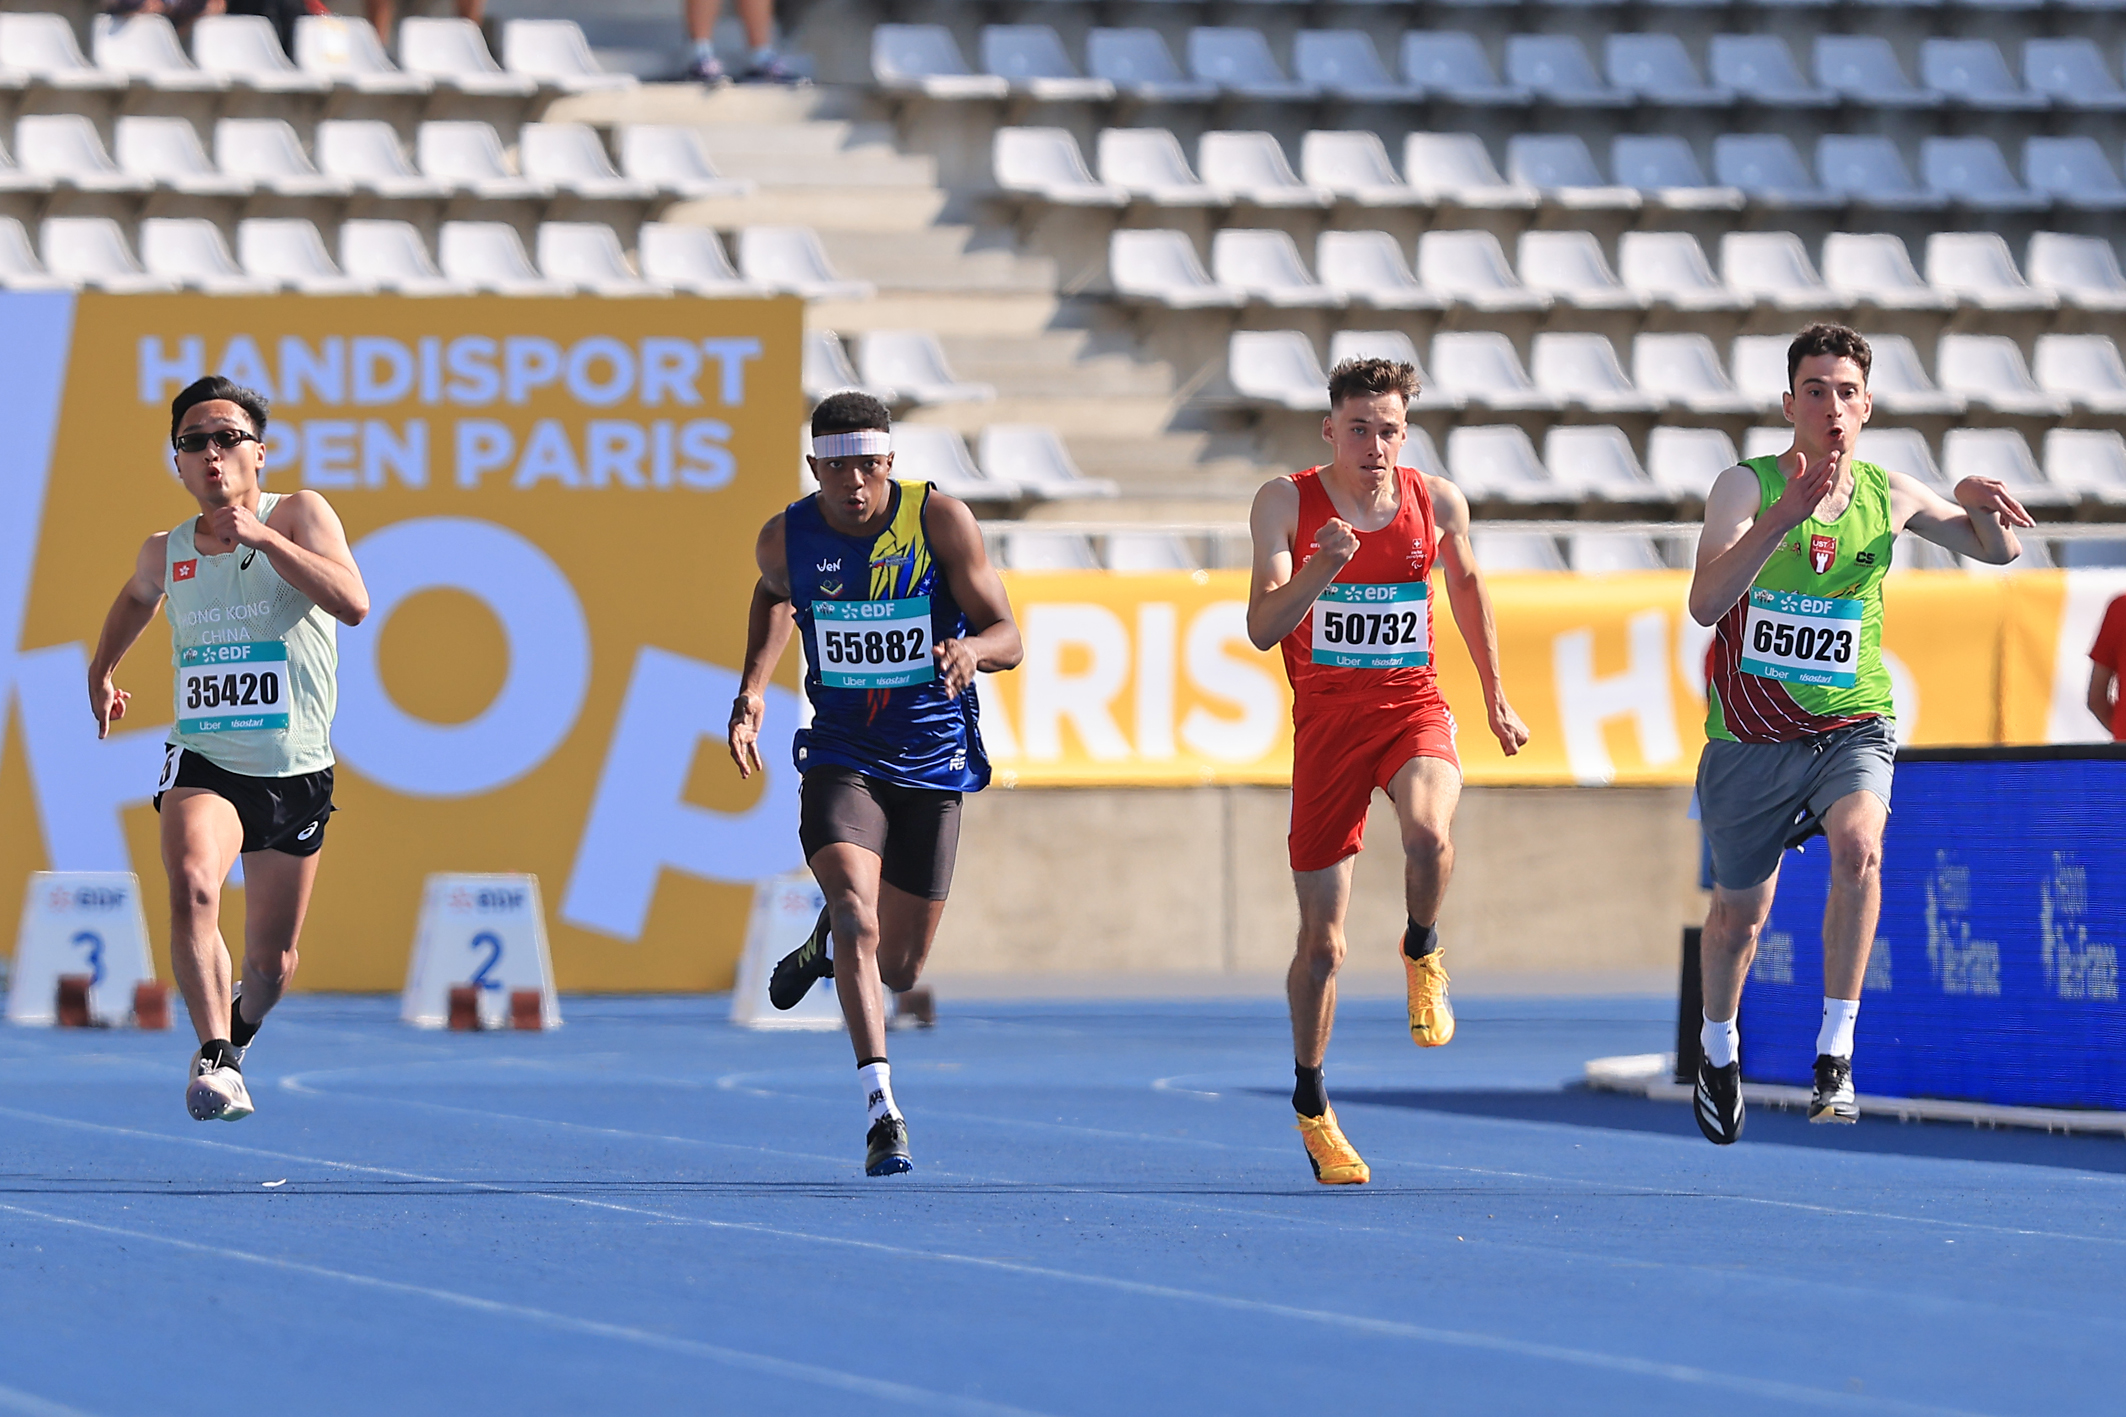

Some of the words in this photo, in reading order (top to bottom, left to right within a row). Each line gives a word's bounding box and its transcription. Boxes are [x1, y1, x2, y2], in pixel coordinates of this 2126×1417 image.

[138, 335, 762, 406] HANDISPORT
[163, 419, 431, 489] PEN
[454, 419, 738, 490] PARIS
[182, 608, 221, 627] HONG
[226, 601, 270, 620] KONG
[1324, 611, 1417, 645] 50732
[202, 626, 251, 645] CHINA
[825, 627, 925, 664] 55882
[1753, 620, 1852, 663] 65023
[1336, 655, 1361, 666] Uber
[1764, 666, 1789, 679] Uber
[187, 672, 279, 709] 35420
[842, 676, 866, 686] Uber
[199, 721, 221, 731] Uber
[71, 931, 106, 986] 3
[471, 932, 503, 990] 2
